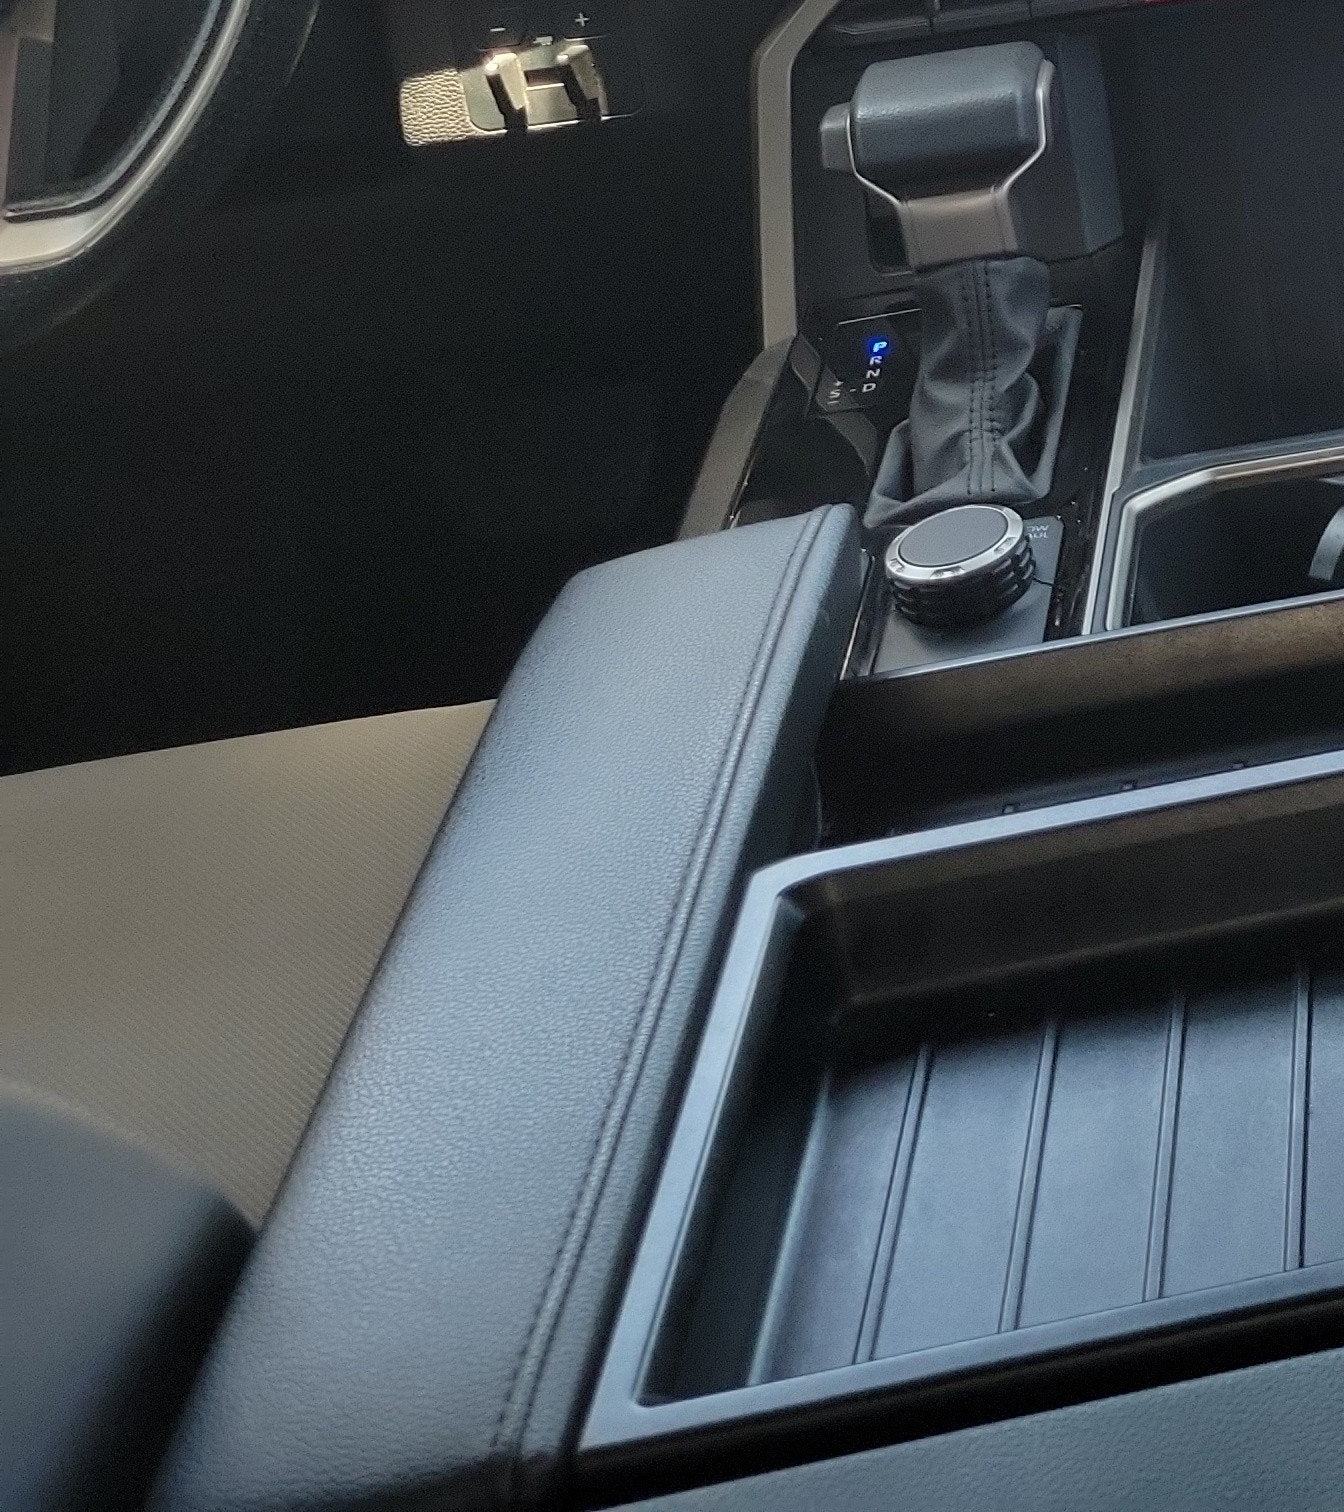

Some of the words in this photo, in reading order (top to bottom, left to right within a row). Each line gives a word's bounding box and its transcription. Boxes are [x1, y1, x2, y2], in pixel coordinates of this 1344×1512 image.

[873, 341, 888, 353] P
[870, 355, 882, 366] R
[866, 368, 880, 379] N
[862, 383, 876, 392] D
